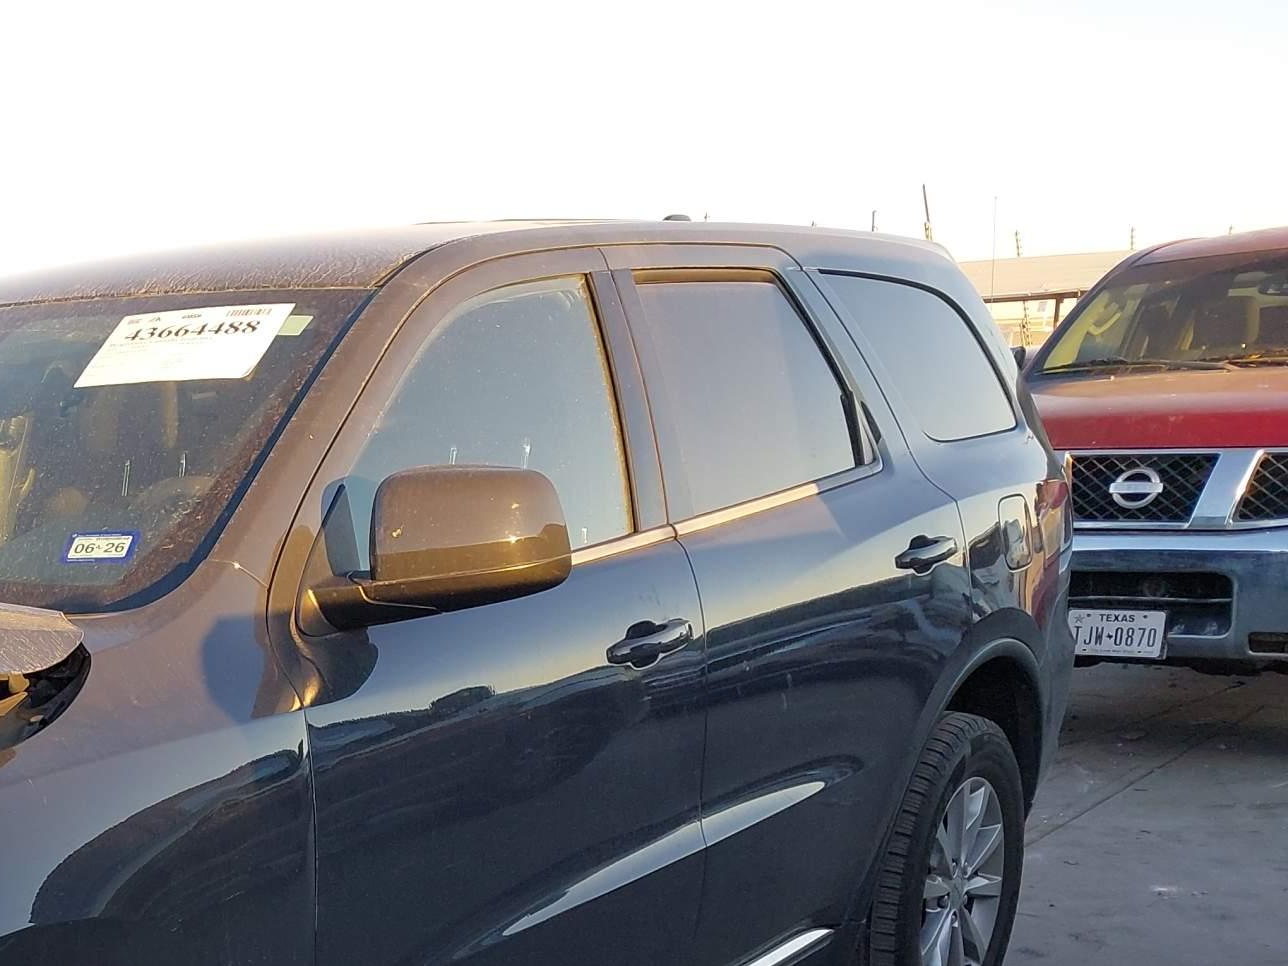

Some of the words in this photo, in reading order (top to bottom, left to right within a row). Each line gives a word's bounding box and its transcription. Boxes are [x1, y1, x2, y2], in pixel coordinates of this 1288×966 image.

[124, 320, 261, 341] 43664488
[74, 542, 96, 554] 06
[103, 542, 126, 553] 26
[1099, 613, 1136, 623] TEXAS
